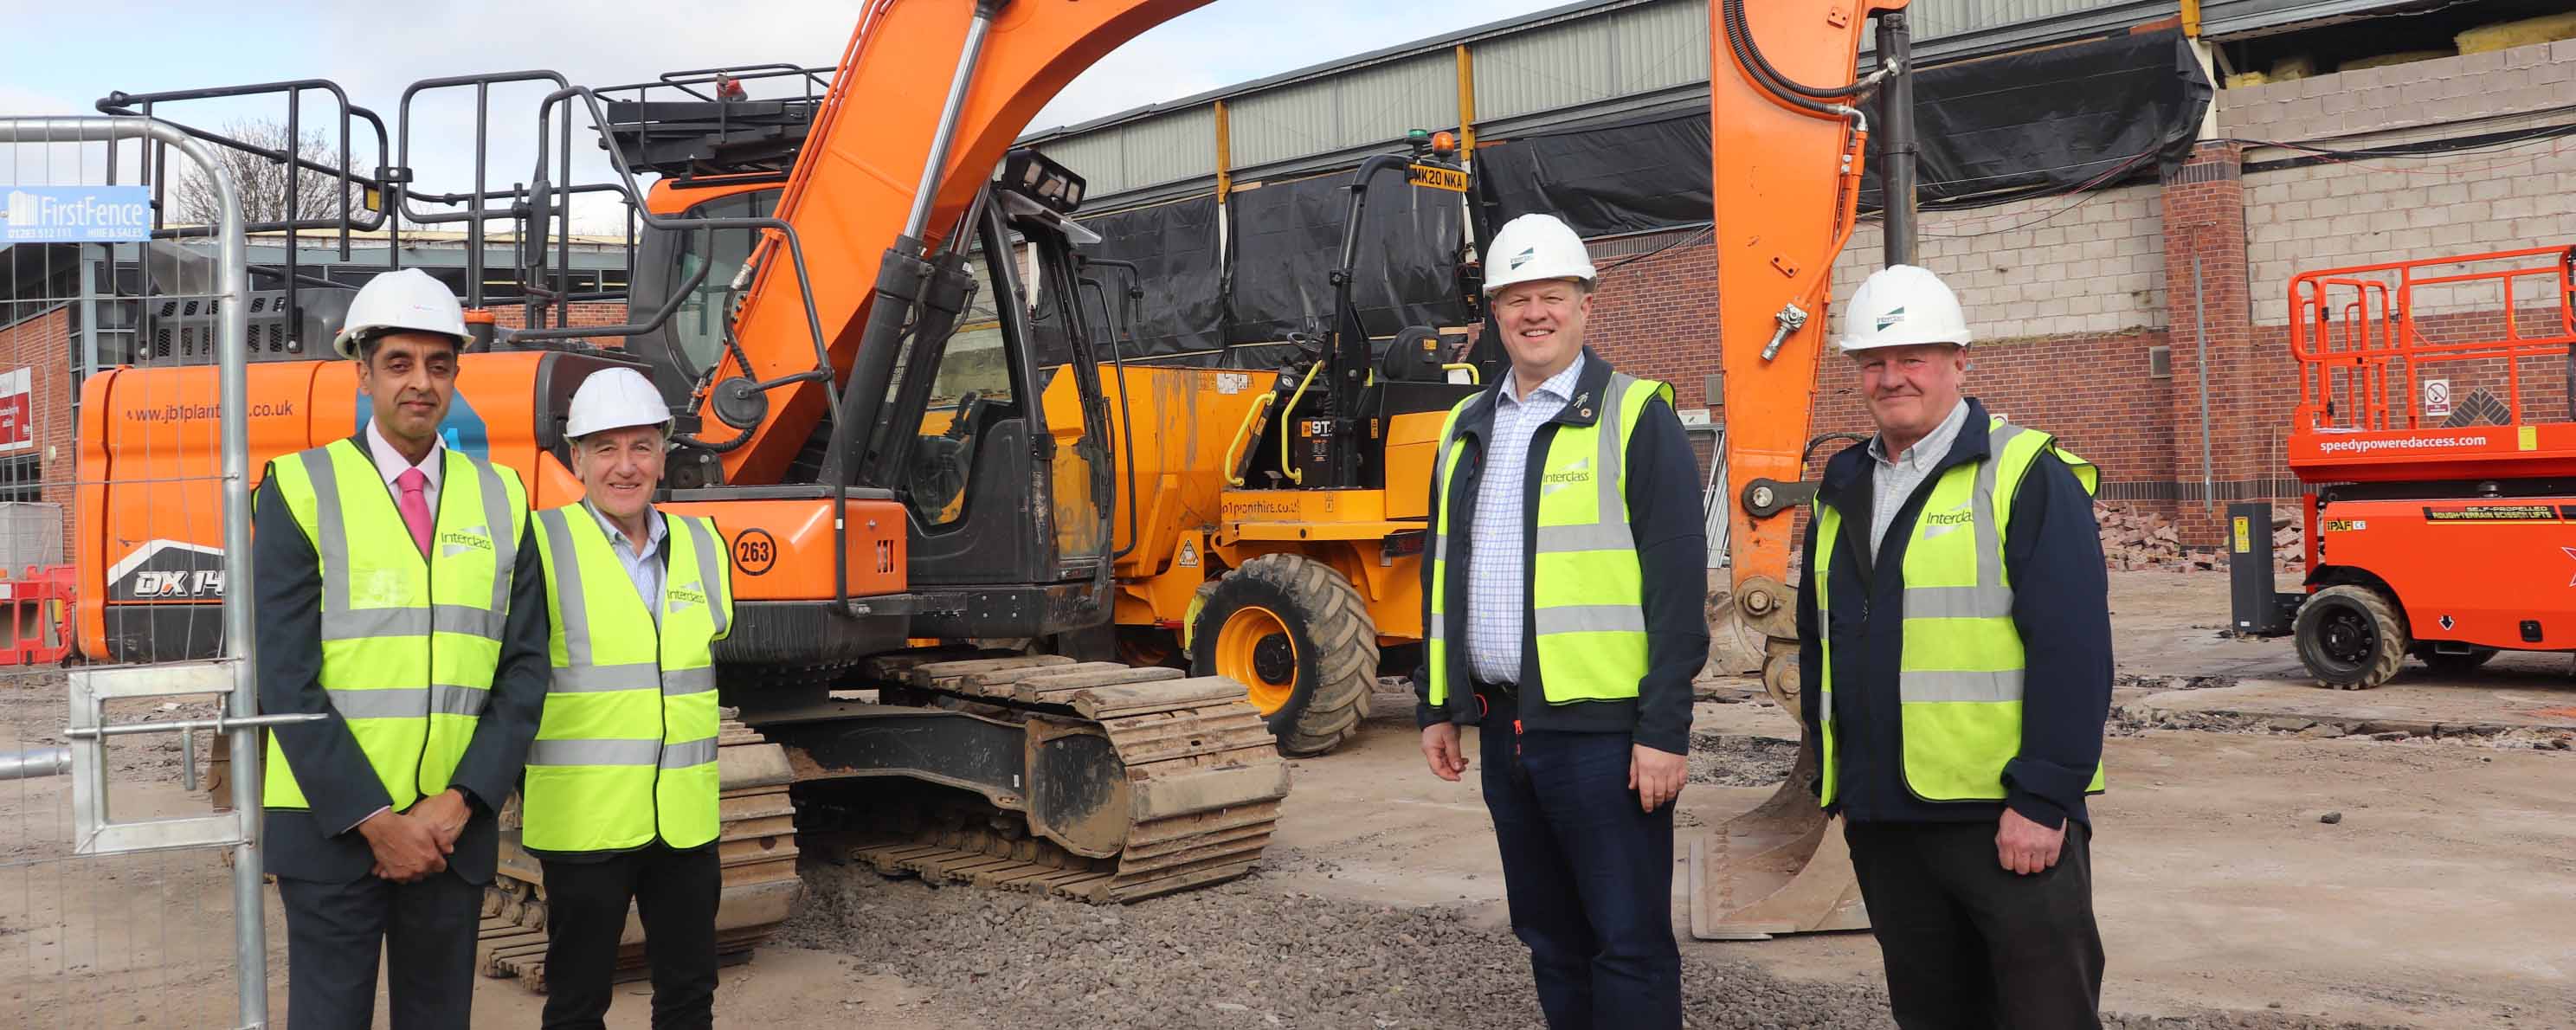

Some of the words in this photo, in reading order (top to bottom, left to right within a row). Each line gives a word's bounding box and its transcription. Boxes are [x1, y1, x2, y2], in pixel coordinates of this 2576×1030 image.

[1444, 172, 1463, 189] NKA
[41, 196, 143, 226] FirstFence
[37, 228, 55, 237] 512
[116, 228, 143, 237] SALES
[2320, 436, 2486, 454] speedypoweredaccess.com
[1543, 471, 1589, 483] Interclass
[2327, 518, 2352, 531] IPAF
[441, 532, 492, 550] Interclass
[740, 542, 770, 563] 263
[134, 570, 189, 597] DX
